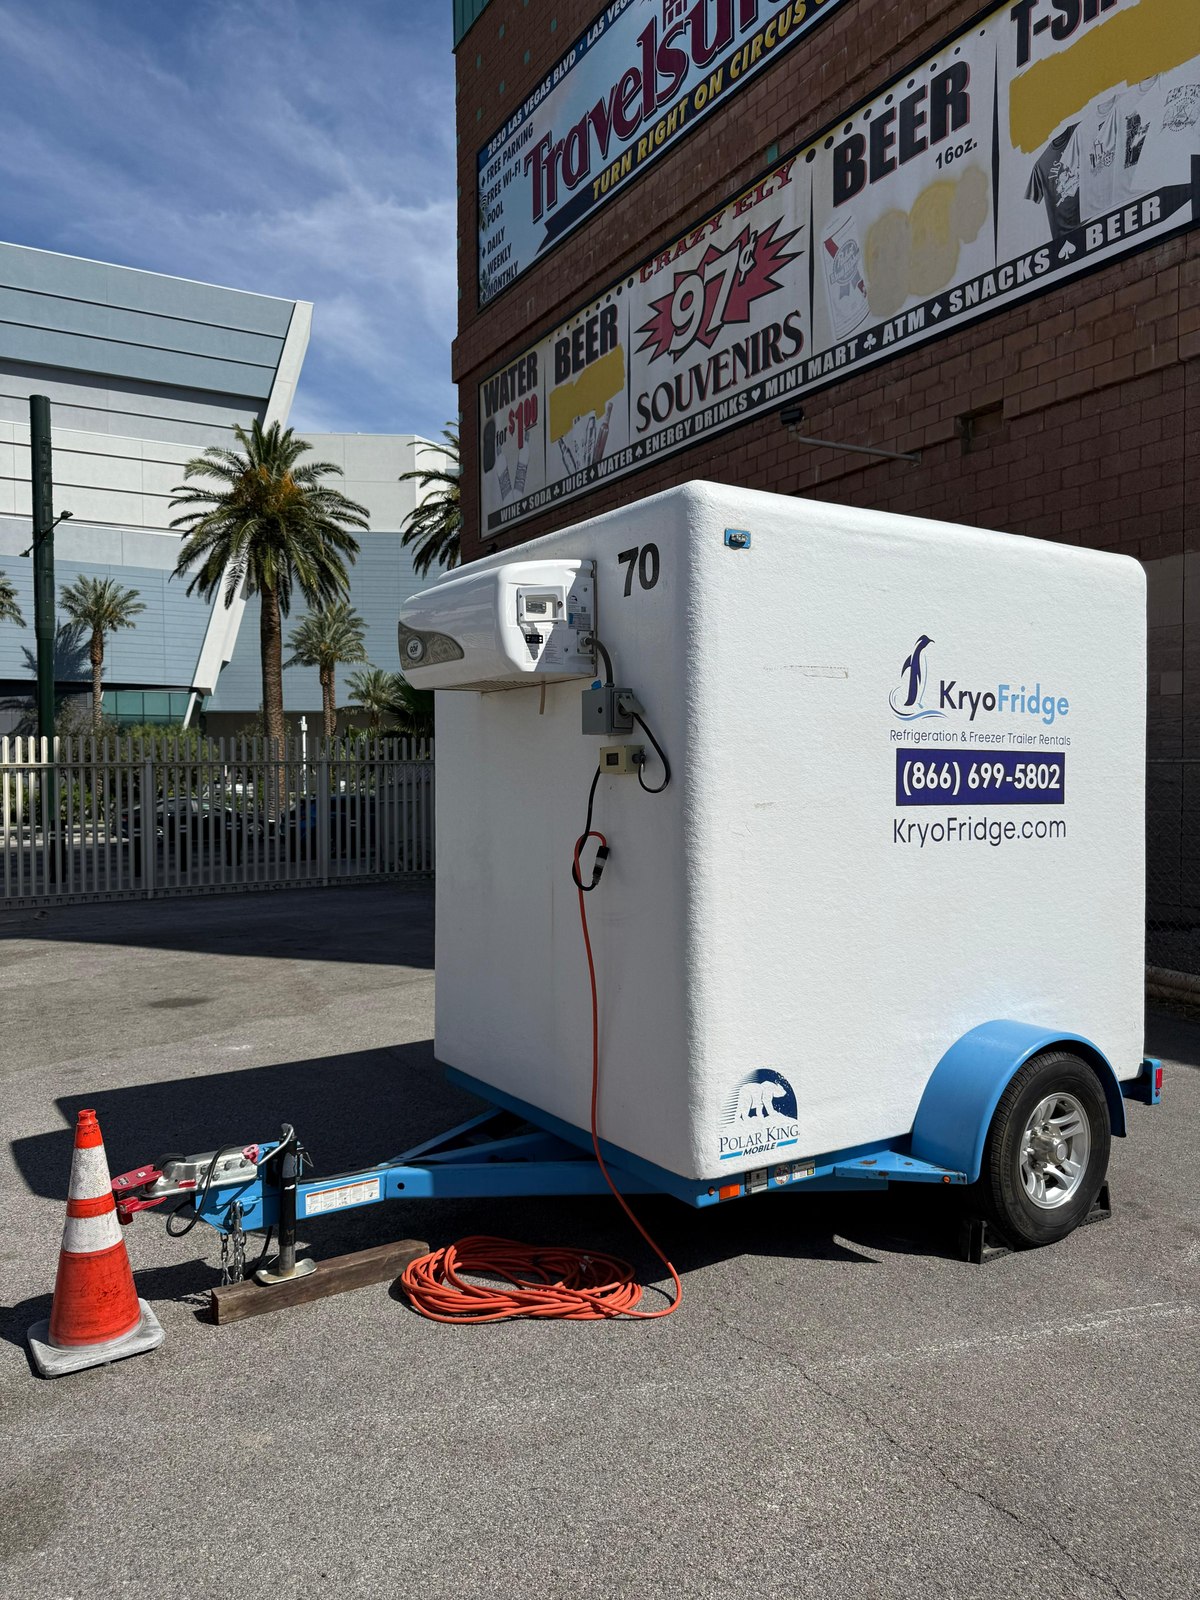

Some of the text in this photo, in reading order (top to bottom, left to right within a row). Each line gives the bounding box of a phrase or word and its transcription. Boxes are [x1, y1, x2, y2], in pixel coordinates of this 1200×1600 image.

[487, 0, 629, 158] 2830 LAS VEGAS BLVD LAS VEG
[593, 150, 632, 200] TURN
[637, 98, 689, 162] RIGHT
[695, 67, 723, 110] ON
[730, 0, 807, 79] CIRCUS
[486, 122, 534, 183] FREE PARKING
[833, 61, 970, 208] BEER
[936, 139, 978, 170] 16oz.
[486, 159, 521, 205] FREE WI-FI
[487, 201, 504, 228] POOL
[639, 157, 797, 284] CRAZY ELY
[487, 226, 505, 255] DAILY
[487, 243, 512, 276] WEEKLY
[486, 260, 518, 298] MONTHLY
[500, 196, 1161, 523] WINE SODA JUICE WATER ENERGY DRINKS MINI MART ATM SNACKS BEER
[555, 304, 618, 386] BEER
[484, 351, 538, 418] WATER
[635, 310, 805, 433] SOUVENIRS
[617, 543, 660, 598] 70
[940, 680, 1069, 725] KryoFridge
[890, 729, 1071, 746] Refrigeration & Freezer Trailer Rentals
[903, 761, 1061, 796] (866) 699-5802
[893, 816, 1066, 848] KryoFridge.com
[719, 1132, 762, 1152] POLAR
[743, 1143, 777, 1157] MOBILE
